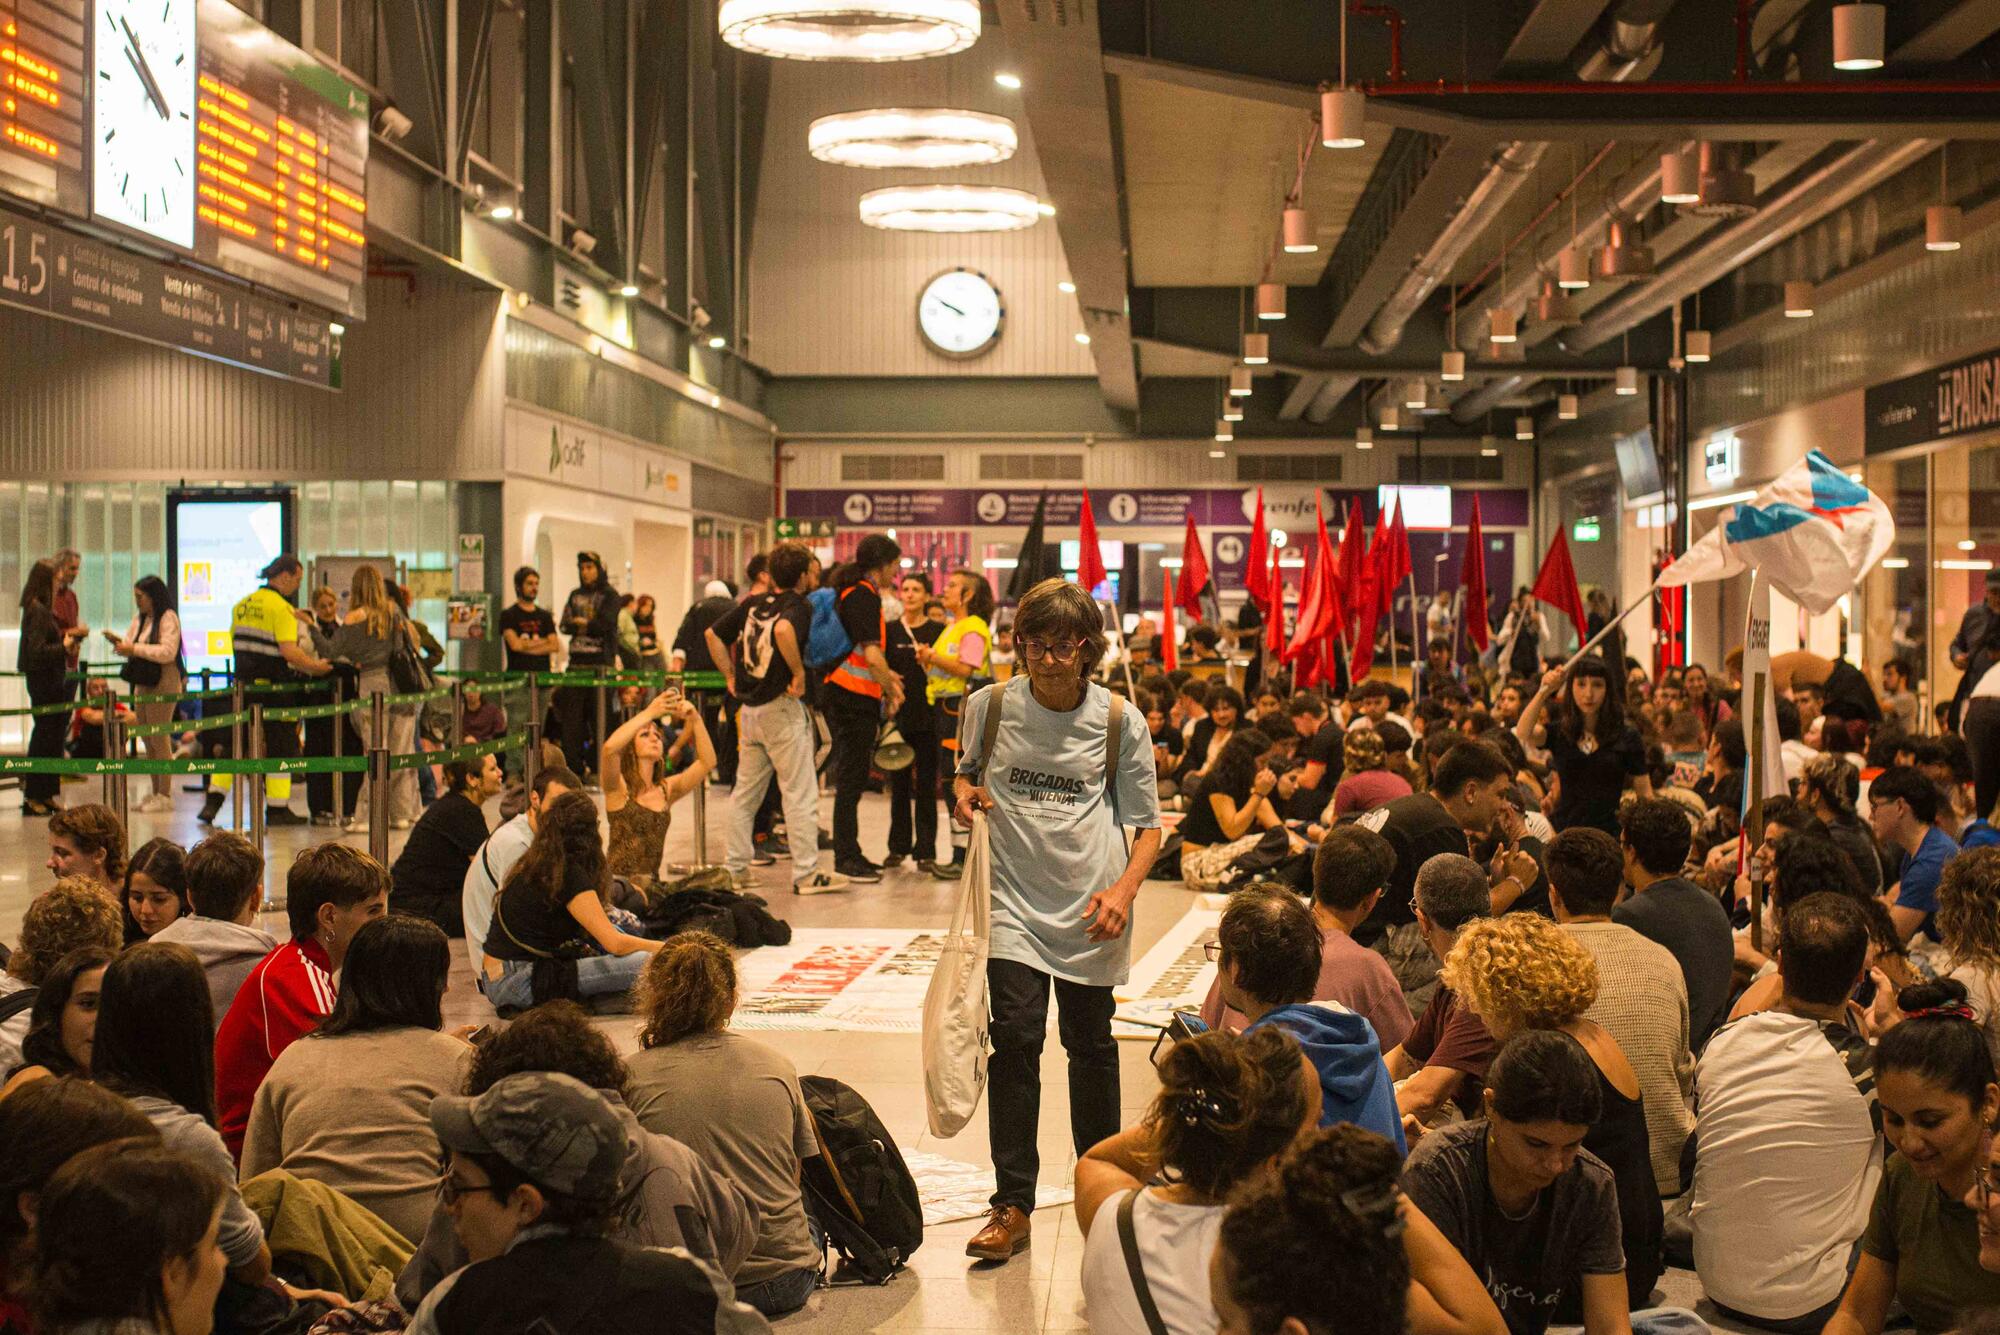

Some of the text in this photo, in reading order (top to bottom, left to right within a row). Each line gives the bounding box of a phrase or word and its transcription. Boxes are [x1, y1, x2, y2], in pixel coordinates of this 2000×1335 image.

[2, 226, 46, 295] 1 a 5
[73, 268, 99, 292] Control
[100, 276, 110, 296] de
[1938, 357, 2000, 432] LA PAUSA
[1008, 767, 1085, 794] BRIGADAS
[1030, 788, 1076, 806] VIVENDA
